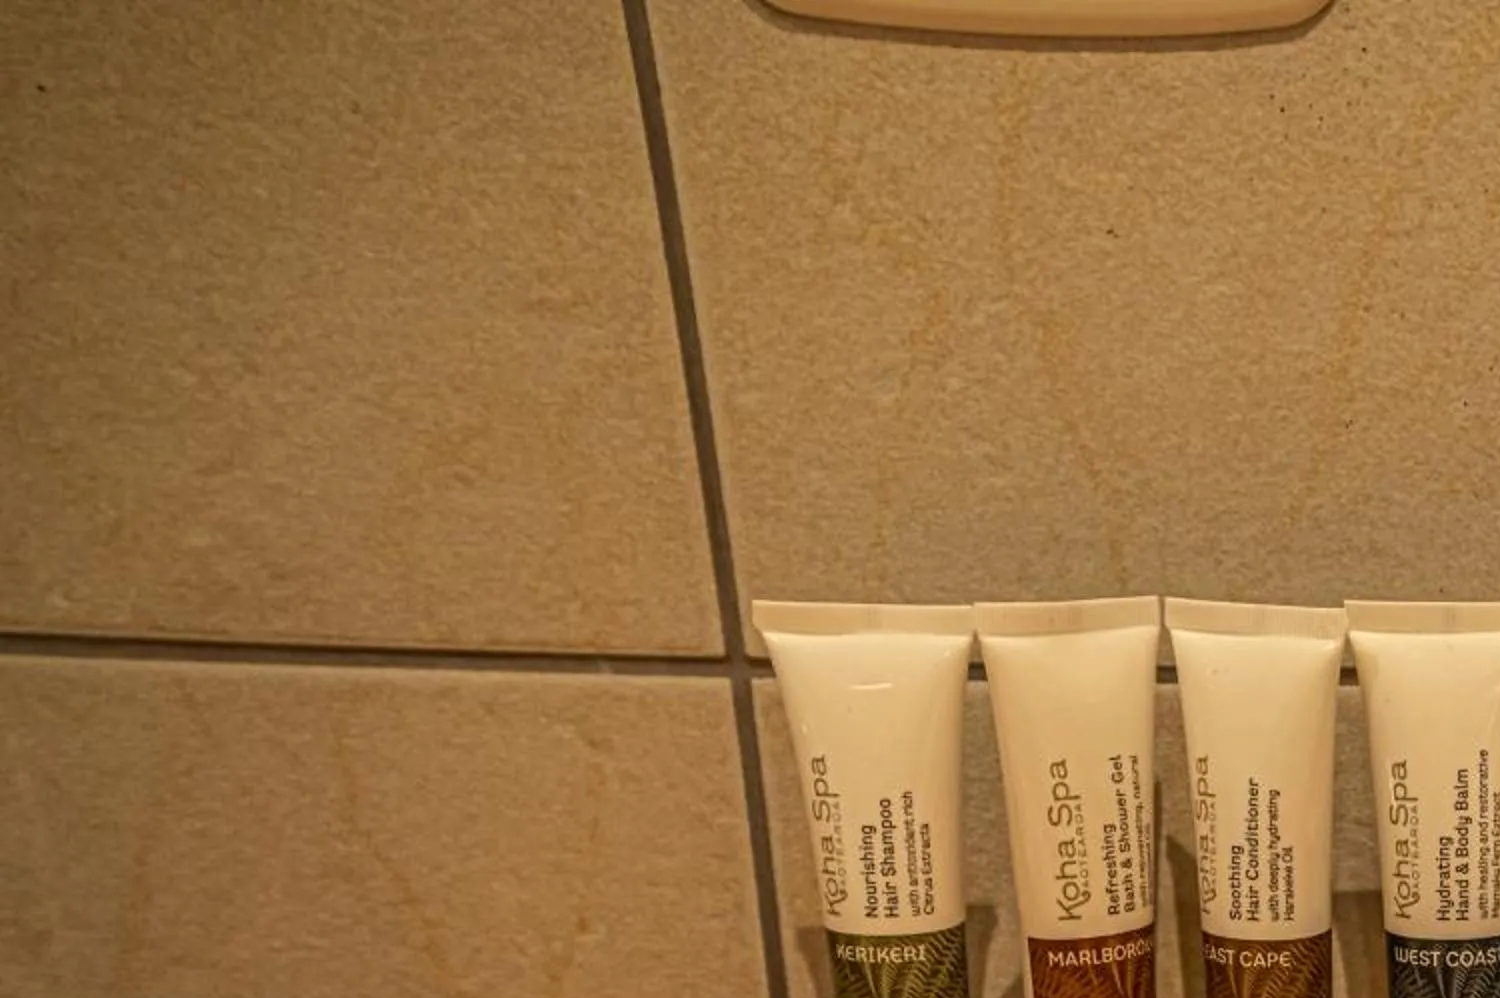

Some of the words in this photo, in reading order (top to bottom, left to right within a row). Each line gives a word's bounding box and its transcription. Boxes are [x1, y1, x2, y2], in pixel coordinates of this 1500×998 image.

[811, 754, 840, 823] Spa
[1048, 757, 1082, 829] Spa
[1108, 754, 1124, 784] Gel
[1195, 754, 1216, 823] Spa
[1389, 759, 1419, 827] Spa
[1453, 768, 1469, 812] Balm
[880, 798, 897, 877] Shampoo
[1115, 790, 1133, 853] Shower
[1244, 777, 1261, 881] Conditioner
[1267, 789, 1280, 849] hydrating
[1455, 815, 1473, 859] Body
[1477, 822, 1488, 845] and
[821, 835, 848, 917] Koha
[859, 824, 879, 919] Nourishing
[1056, 837, 1092, 922] Koha
[1101, 823, 1121, 916] Refreshing
[1120, 857, 1133, 870] &
[1228, 844, 1244, 921] Soothing
[1392, 838, 1420, 919] Koha
[1435, 836, 1454, 921] Hydrating
[1455, 861, 1469, 874] &
[882, 881, 899, 918] Hair
[1120, 870, 1135, 912] Bath
[1246, 885, 1262, 922] Hair
[1267, 893, 1279, 922] with
[1455, 880, 1469, 921] Hand
[835, 943, 926, 963] KERIKERI
[1047, 938, 1152, 968] MARLBORO
[1239, 951, 1291, 969] CAPE
[1394, 945, 1440, 967] WEST
